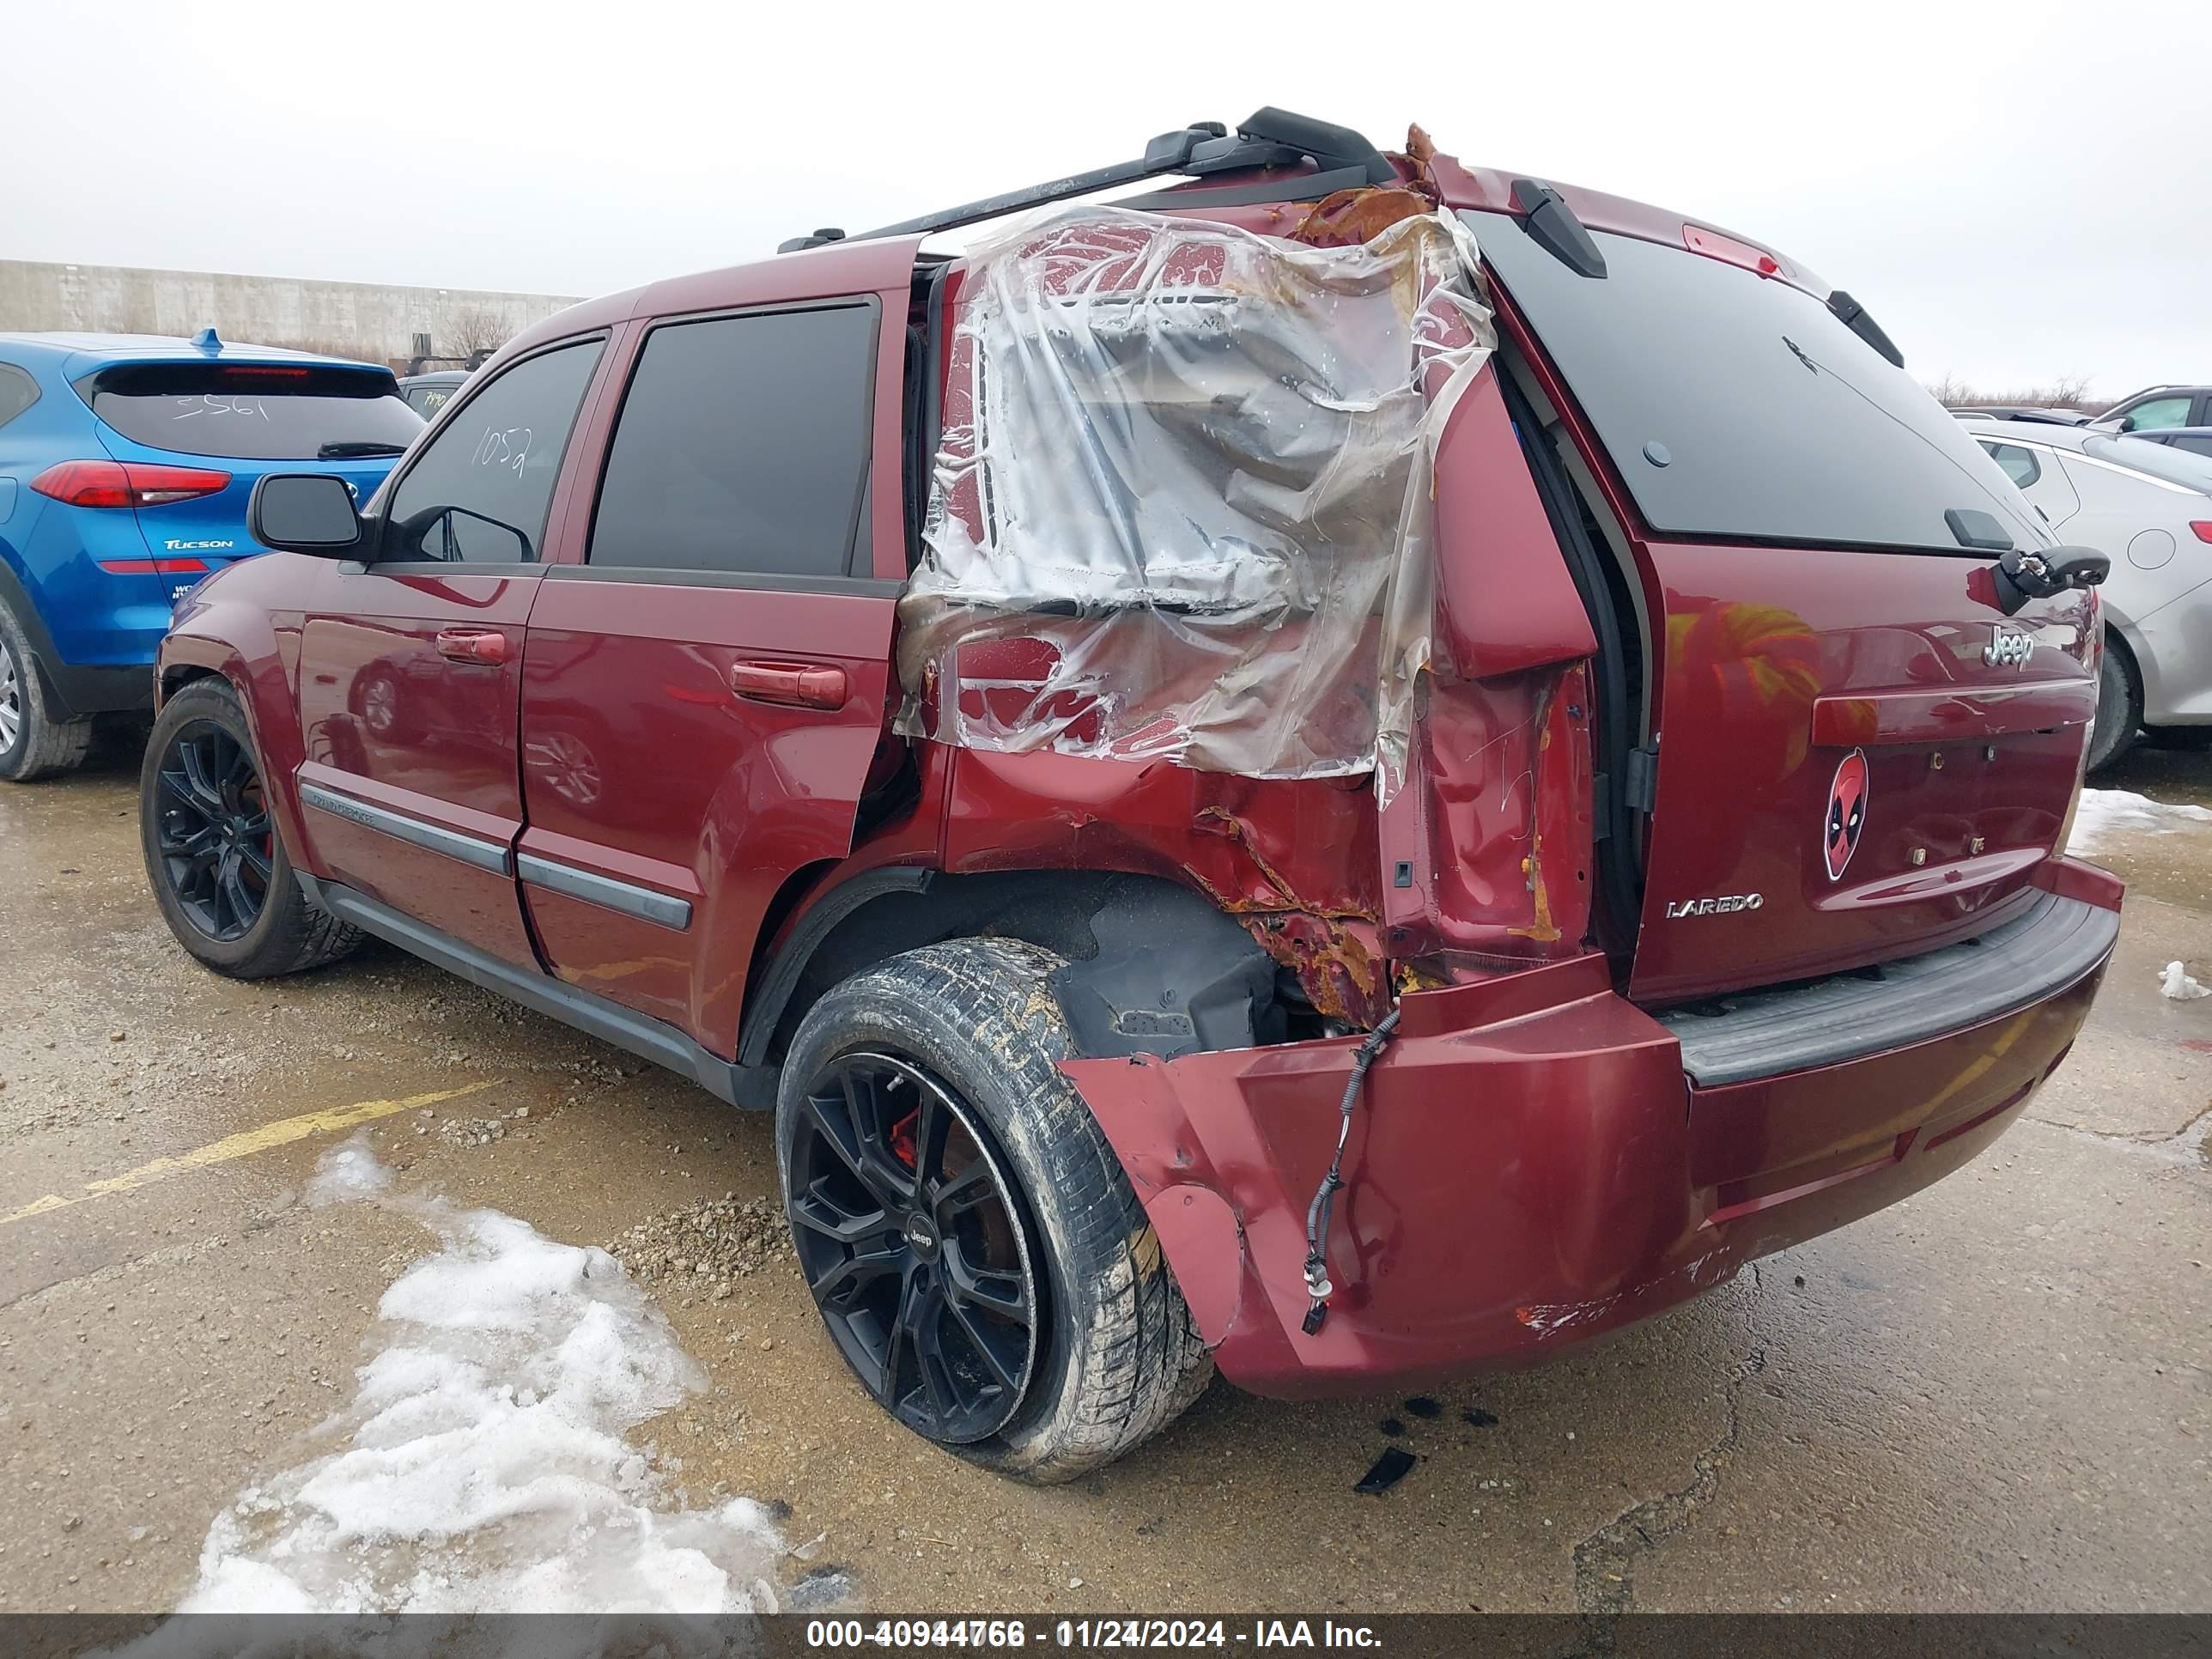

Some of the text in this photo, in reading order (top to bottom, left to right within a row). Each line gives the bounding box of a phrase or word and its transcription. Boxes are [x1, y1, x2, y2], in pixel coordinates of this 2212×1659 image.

[471, 426, 532, 478] 1052
[163, 538, 234, 550] TUCSON
[1984, 626, 2034, 672] Jeep
[1665, 893, 1764, 919] LAREDO
[910, 1229, 933, 1248] Jeep
